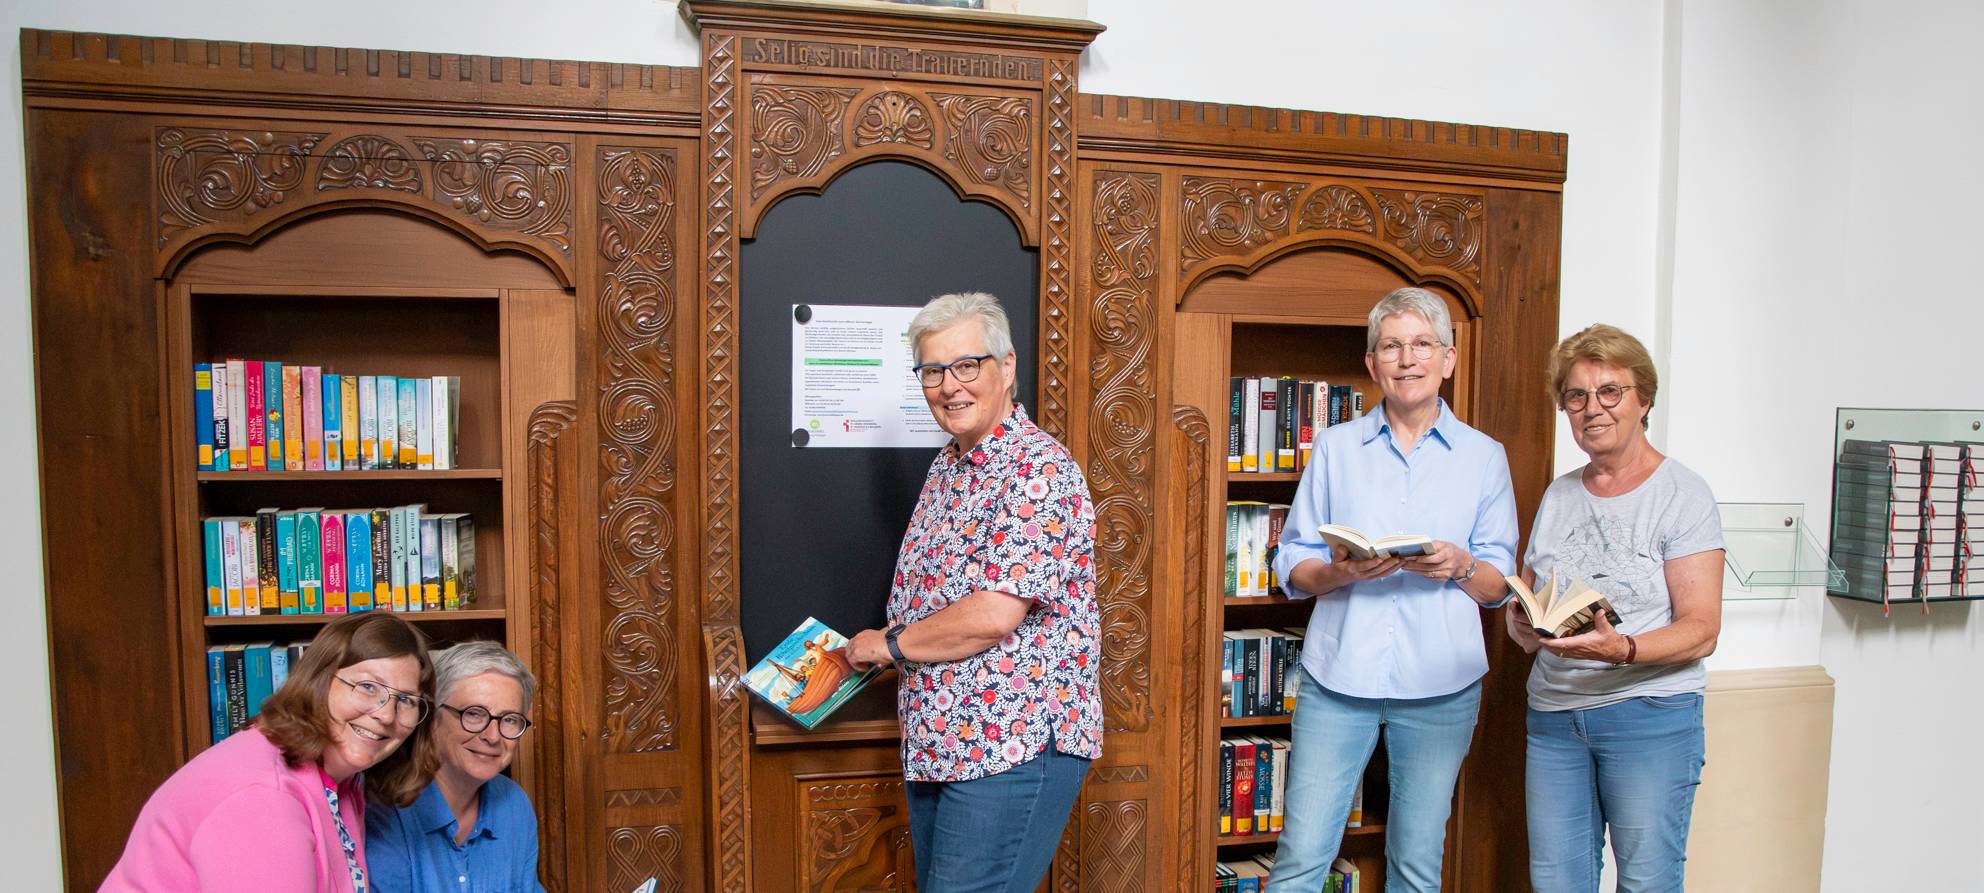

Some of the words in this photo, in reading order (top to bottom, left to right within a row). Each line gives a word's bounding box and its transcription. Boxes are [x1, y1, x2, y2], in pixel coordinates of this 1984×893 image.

[754, 38, 810, 70] Selig
[816, 43, 862, 67] sind
[869, 45, 901, 70] die
[218, 420, 227, 444] FITZEK
[375, 531, 383, 557] Lawson
[376, 558, 384, 576] Mary
[230, 669, 238, 701] GUNNIS
